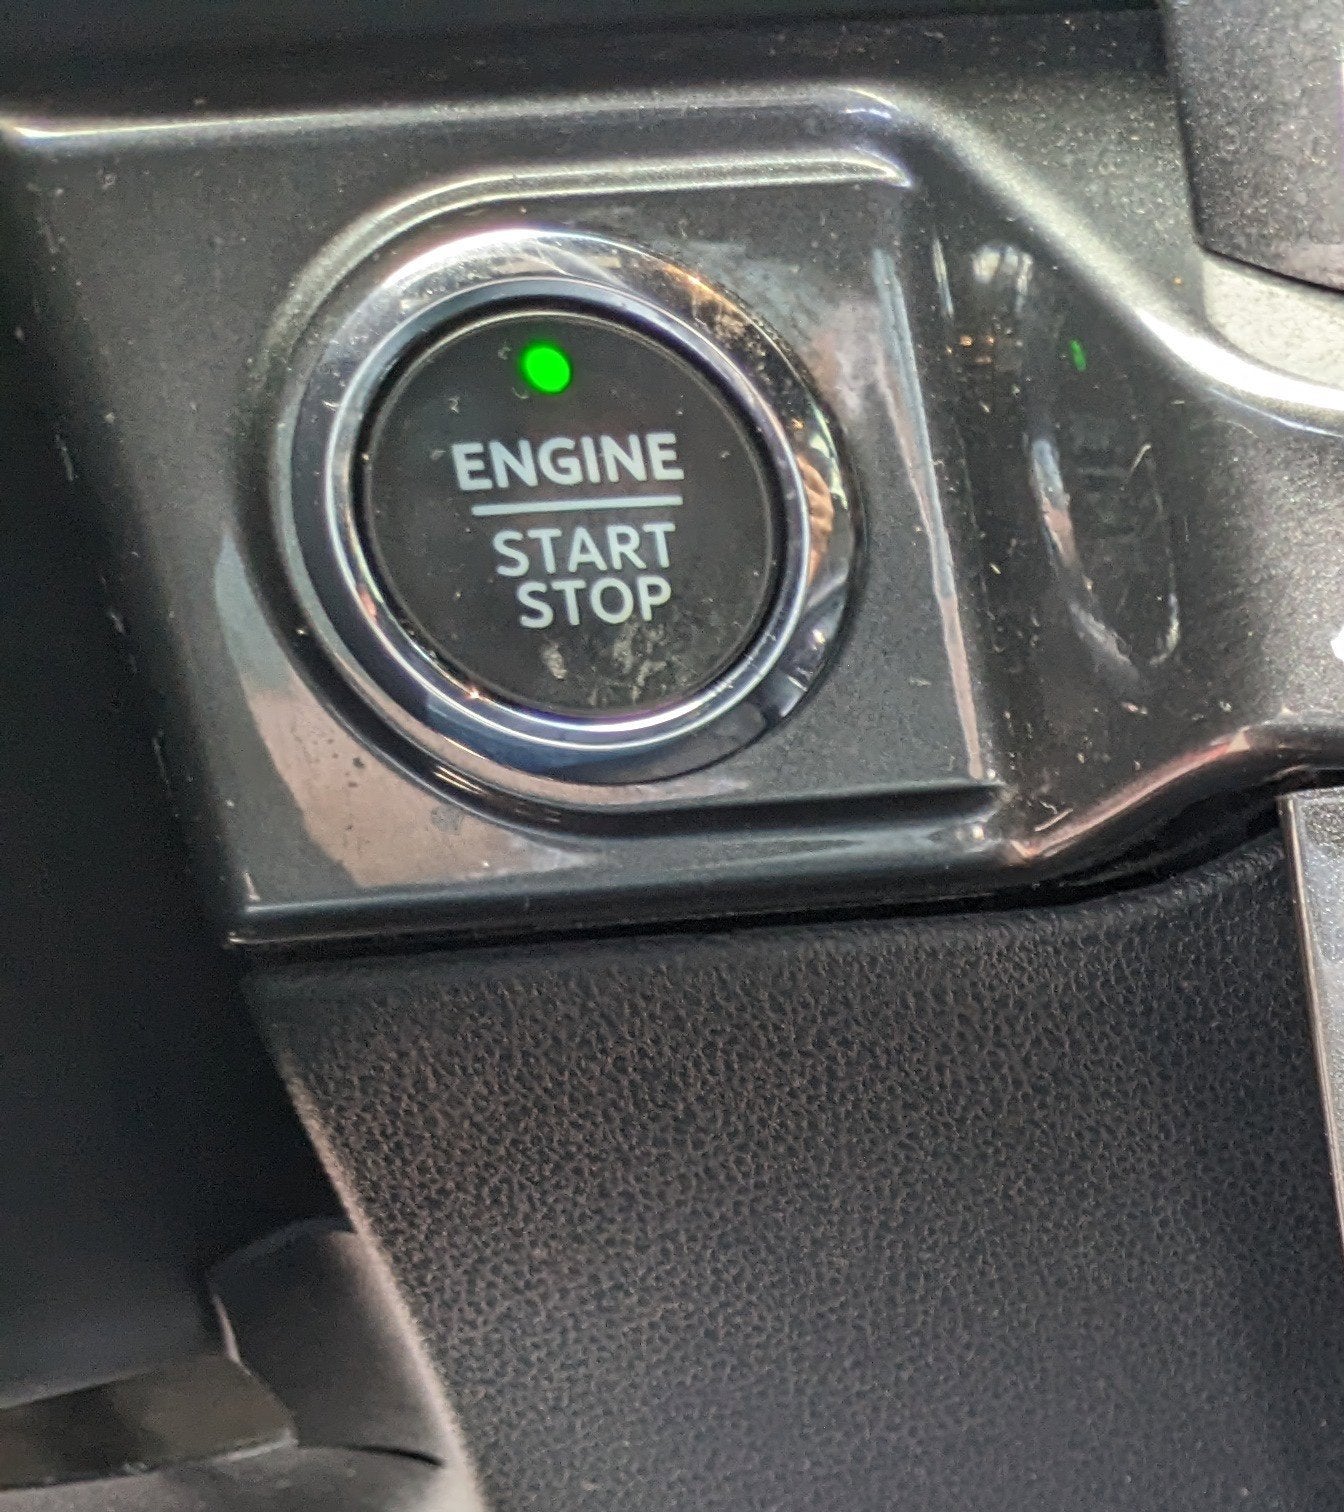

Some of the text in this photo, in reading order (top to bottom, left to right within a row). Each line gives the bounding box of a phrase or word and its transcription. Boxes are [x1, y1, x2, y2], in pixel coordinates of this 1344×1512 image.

[451, 432, 685, 491] ENGINE
[493, 521, 676, 577] START
[516, 575, 672, 628] STOP
